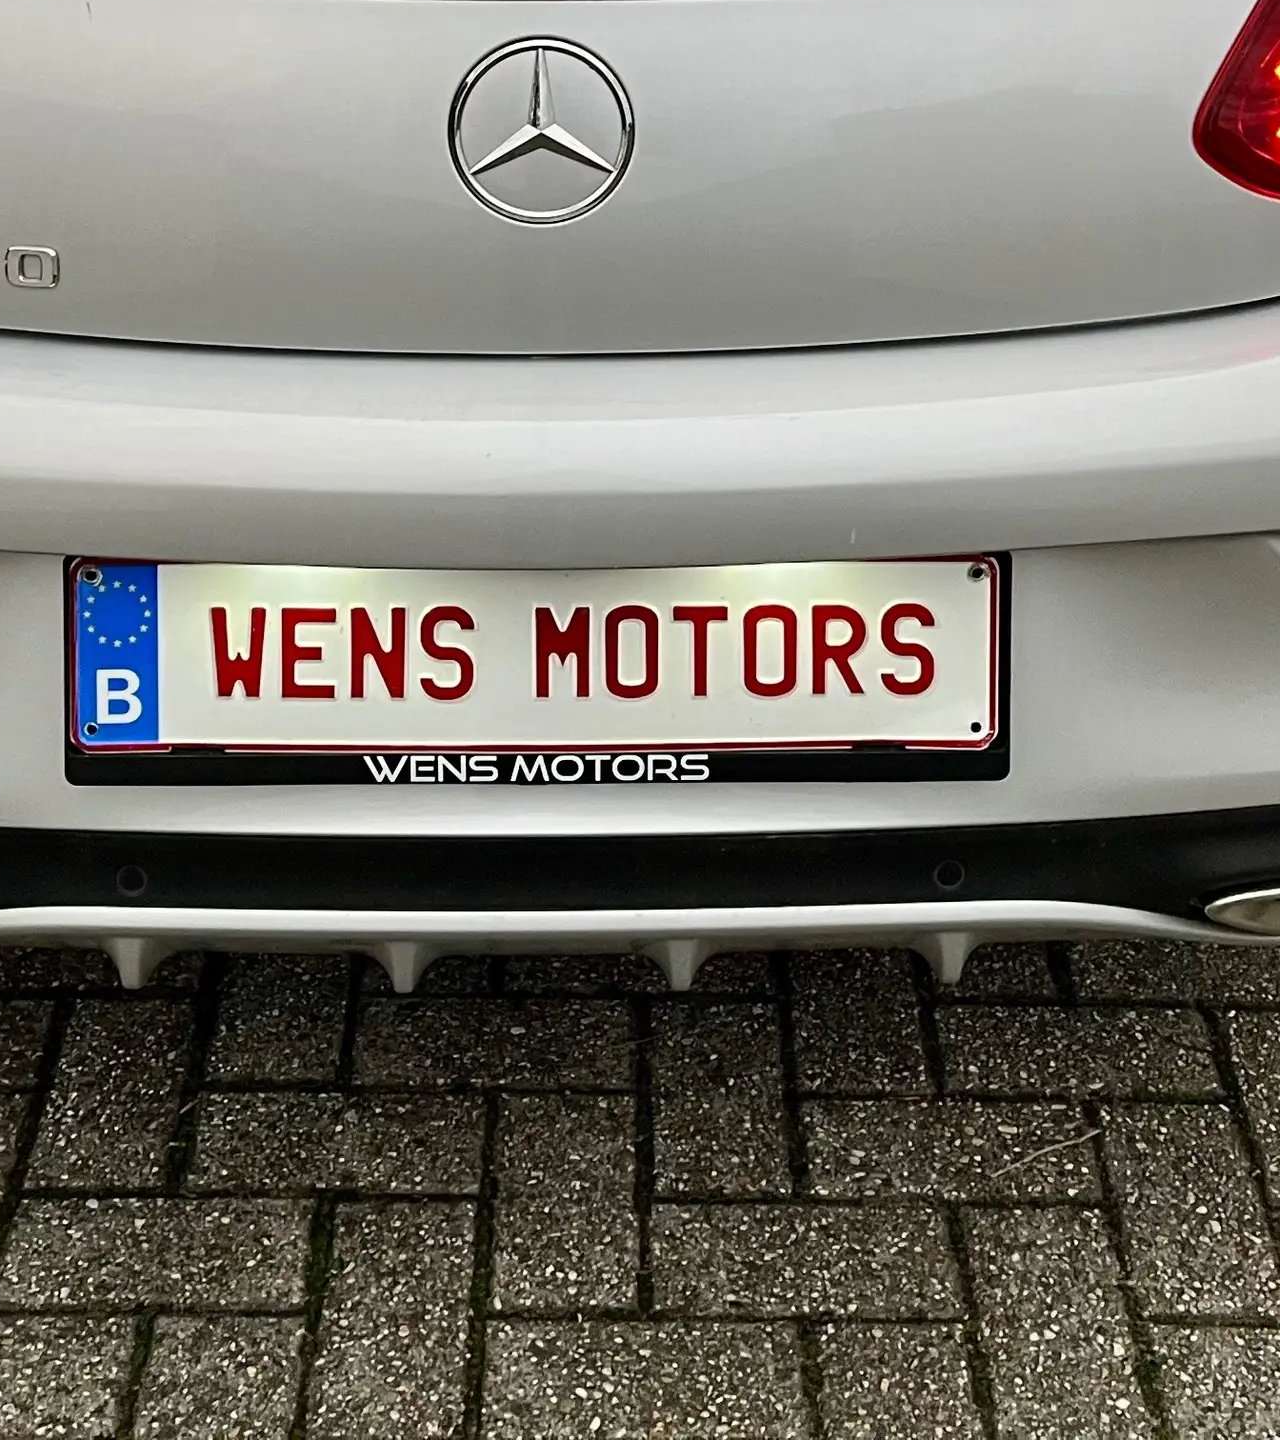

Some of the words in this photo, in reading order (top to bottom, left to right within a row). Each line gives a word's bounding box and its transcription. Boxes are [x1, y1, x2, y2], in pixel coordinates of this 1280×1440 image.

[210, 606, 475, 702] WENS
[537, 602, 936, 700] MOTORS
[91, 669, 142, 729] B
[363, 754, 499, 783] WENS
[510, 753, 711, 783] MOTORS
